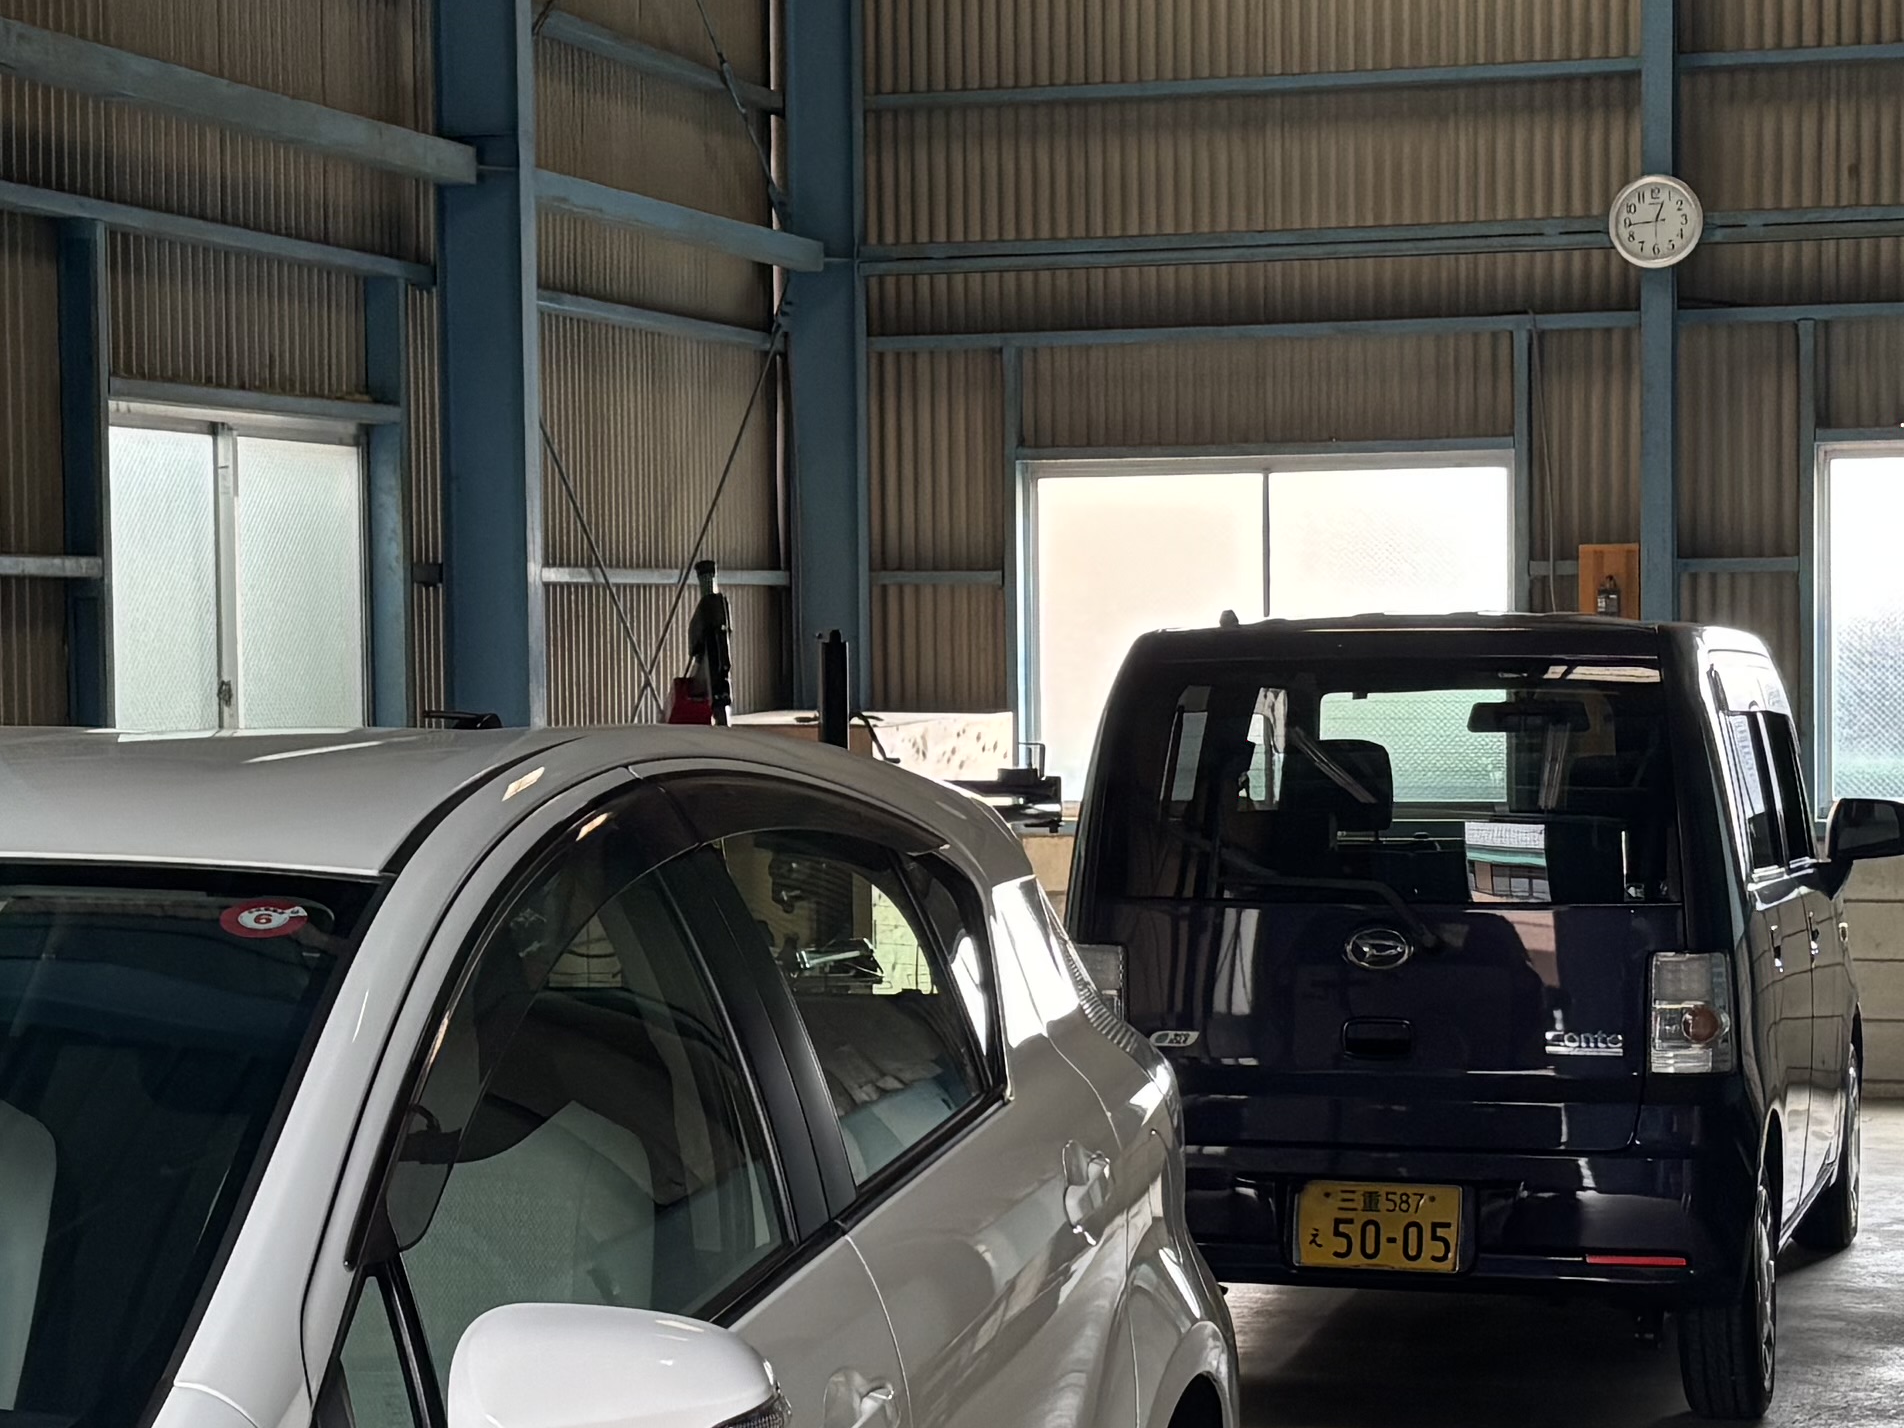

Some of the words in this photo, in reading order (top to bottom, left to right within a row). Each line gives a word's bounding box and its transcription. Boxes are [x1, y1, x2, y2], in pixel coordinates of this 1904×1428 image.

[1637, 191, 1645, 204] 11
[1651, 187, 1660, 199] 12
[1627, 203, 1636, 214] 10
[1676, 200, 1684, 211] 2
[1624, 217, 1632, 228] 9
[1680, 214, 1688, 225] 3
[1627, 231, 1635, 242] 8
[1676, 228, 1684, 240] 4
[1638, 241, 1646, 253] 7
[1652, 243, 1660, 256] 6
[1668, 239, 1675, 250] 5
[1308, 1227, 1323, 1248] え
[1331, 1217, 1452, 1262] 50-05
